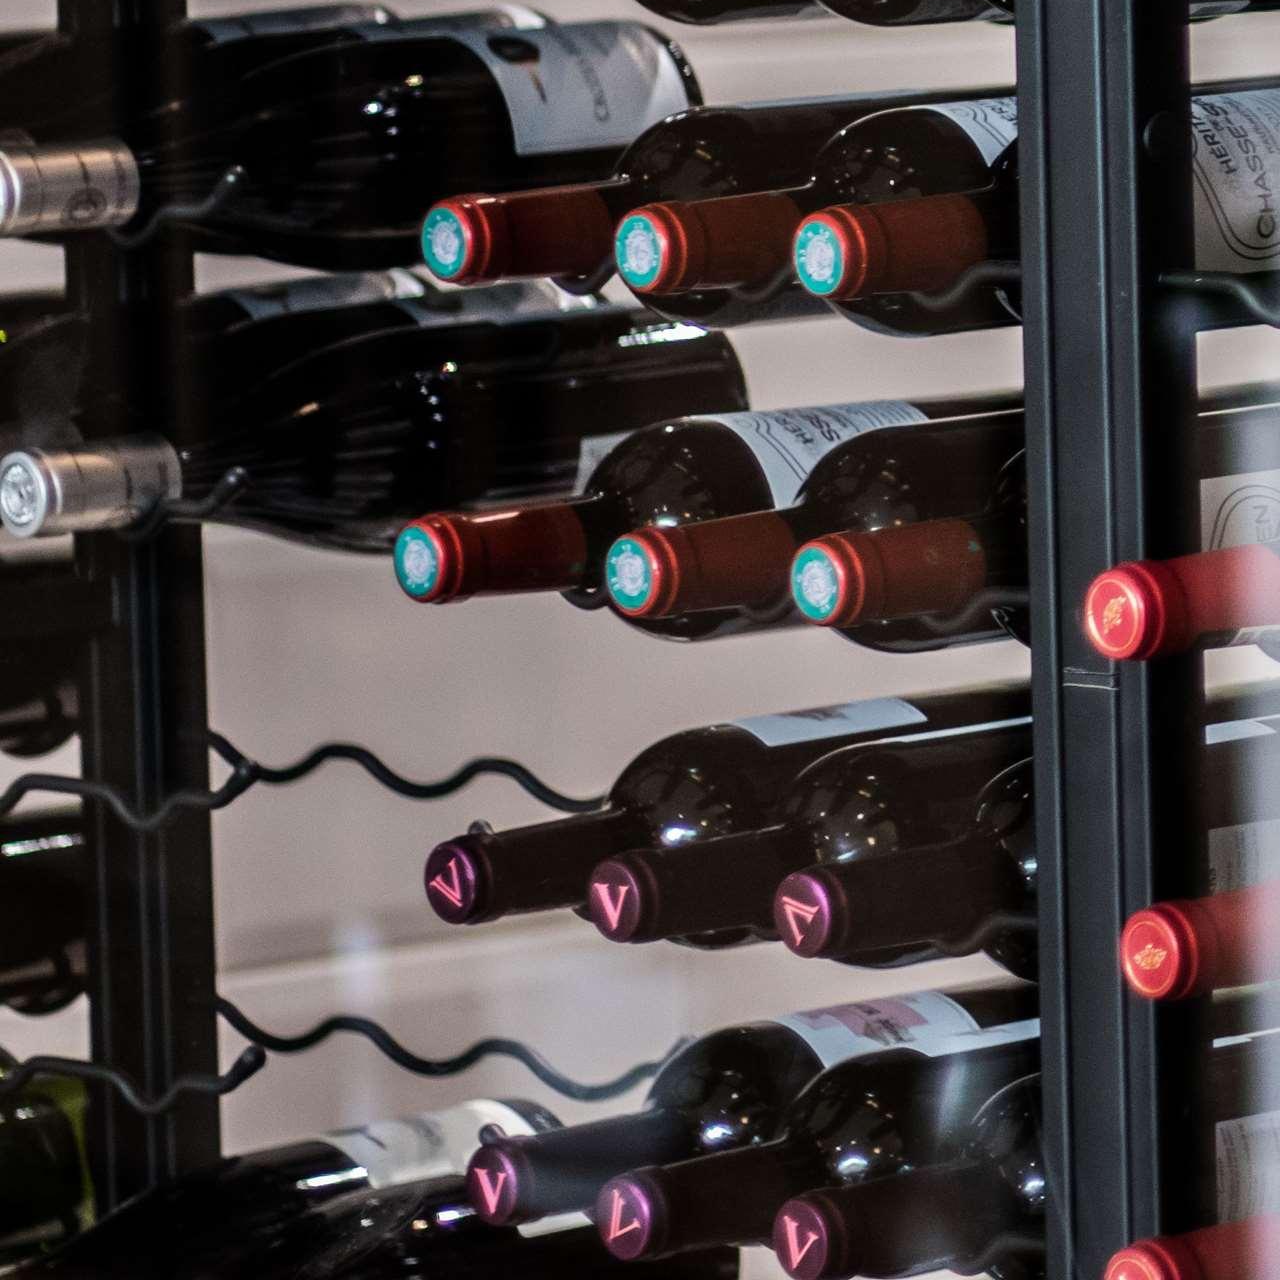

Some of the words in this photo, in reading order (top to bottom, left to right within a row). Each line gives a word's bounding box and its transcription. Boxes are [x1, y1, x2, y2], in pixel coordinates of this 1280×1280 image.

[430, 858, 464, 908] V
[593, 883, 630, 932] V
[782, 896, 820, 947] V
[474, 1168, 507, 1215] V
[608, 1189, 641, 1241] V
[784, 1215, 819, 1271] V
